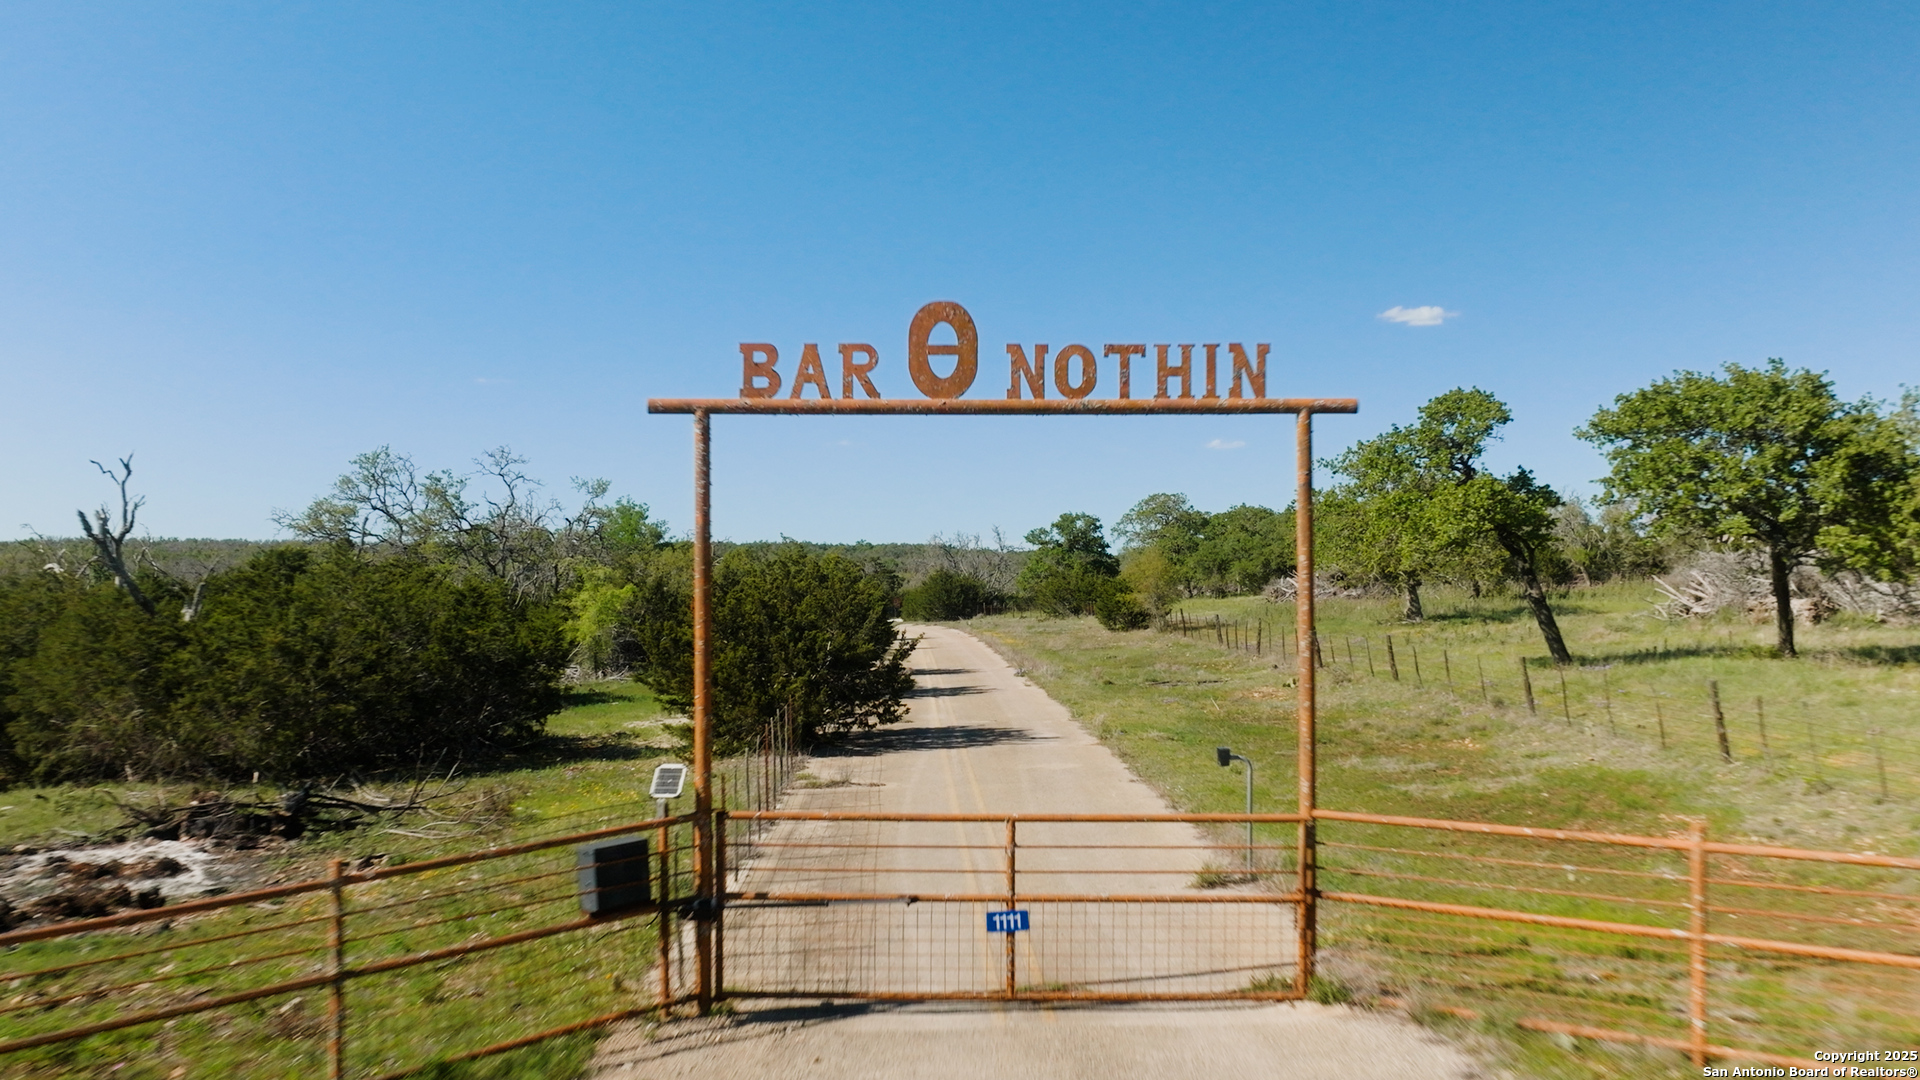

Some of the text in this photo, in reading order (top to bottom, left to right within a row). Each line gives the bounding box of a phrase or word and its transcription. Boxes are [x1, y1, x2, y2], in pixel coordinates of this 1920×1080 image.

[739, 343, 881, 400] BAR
[1006, 343, 1271, 400] NOTHIN
[992, 912, 1022, 930] 1111
